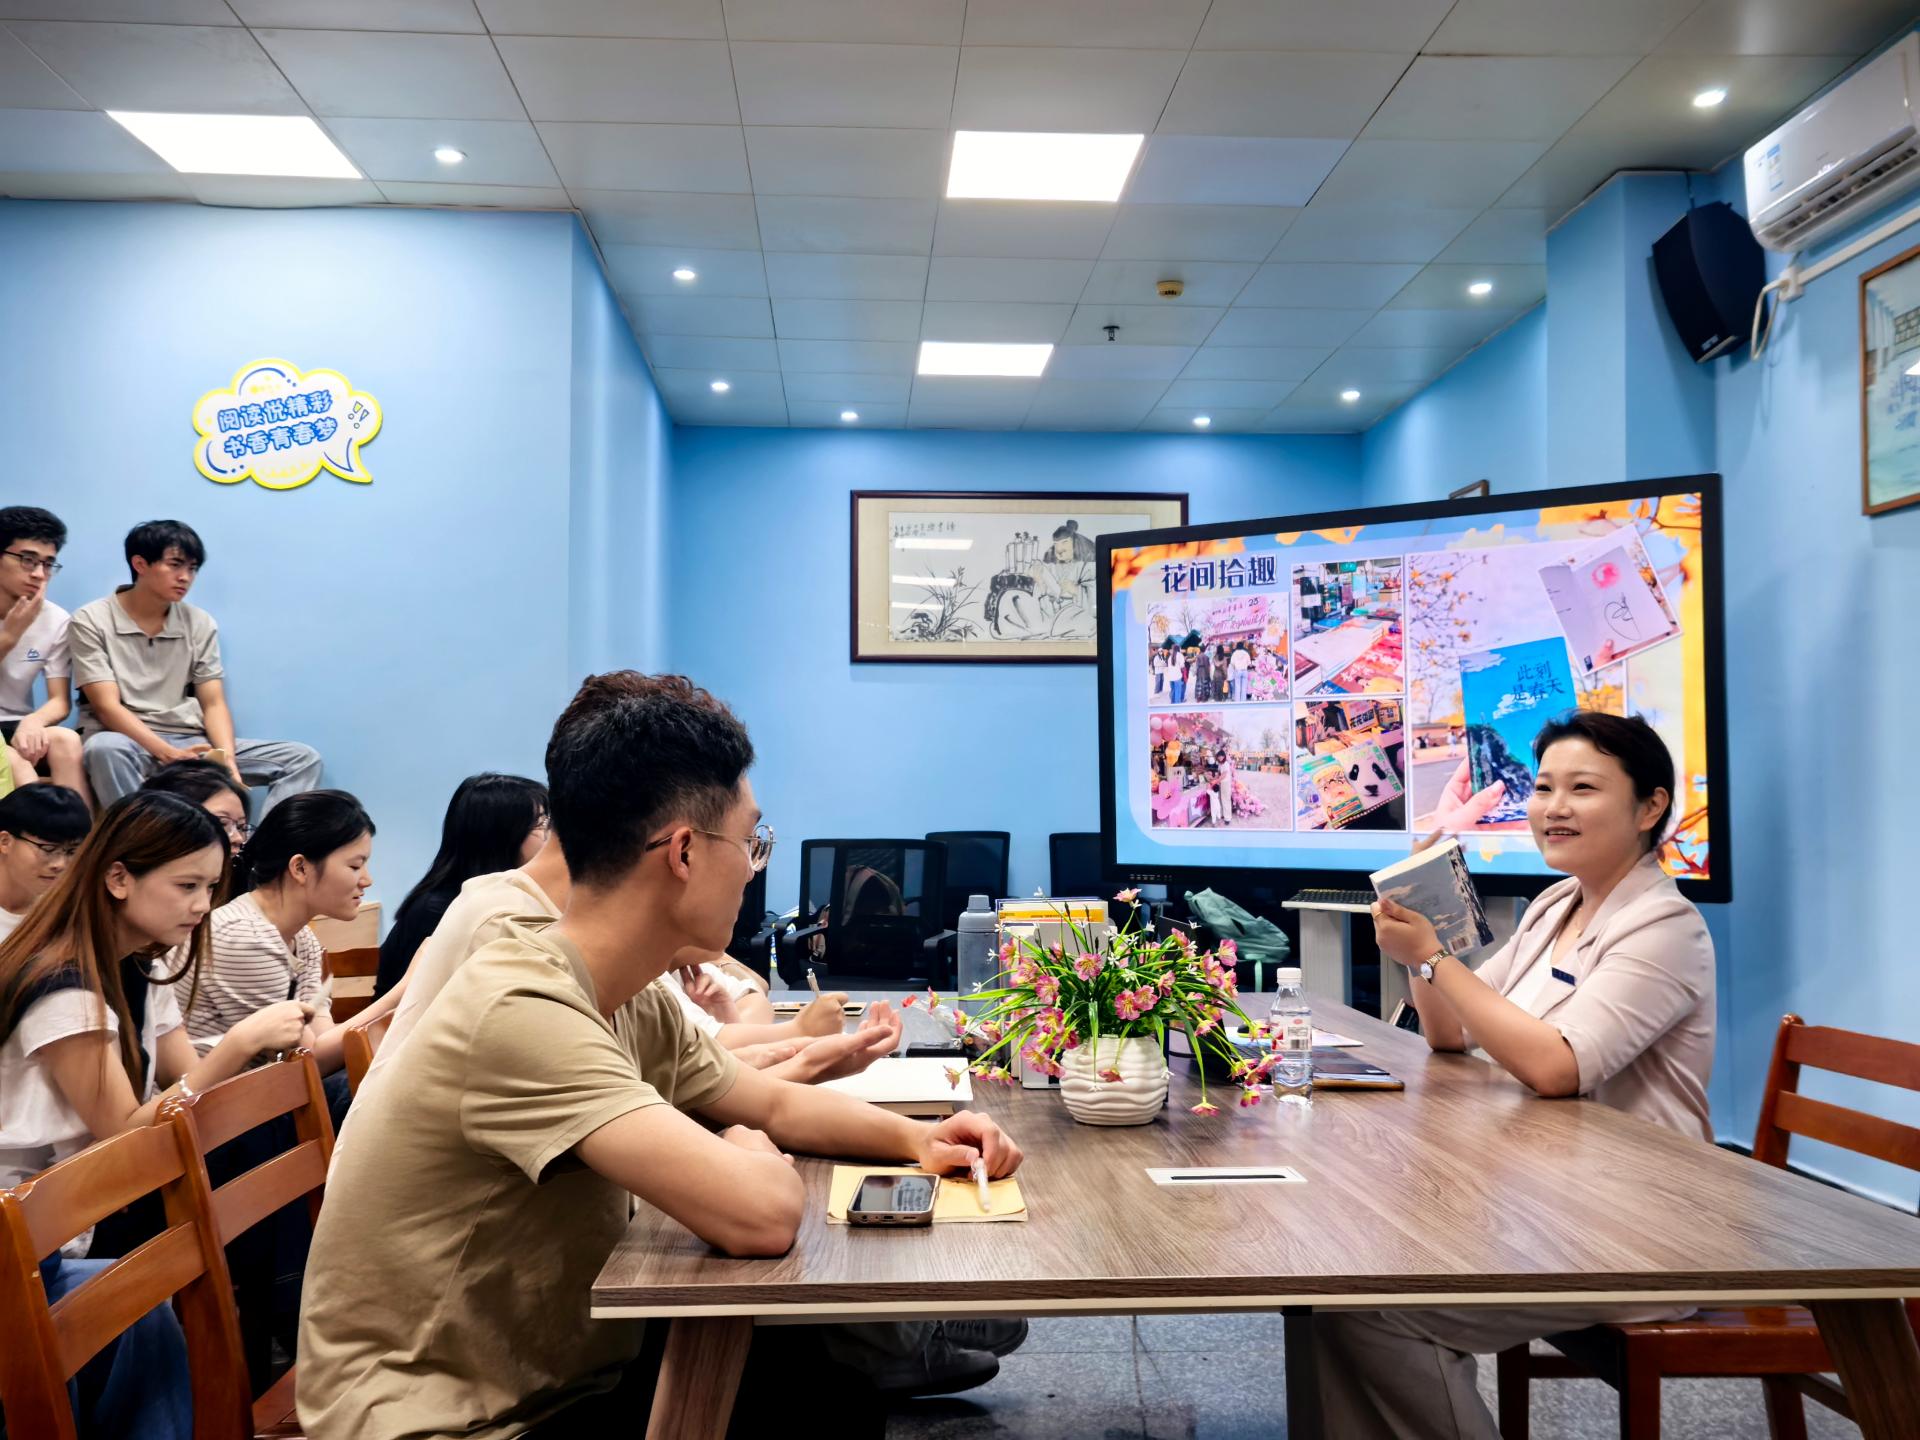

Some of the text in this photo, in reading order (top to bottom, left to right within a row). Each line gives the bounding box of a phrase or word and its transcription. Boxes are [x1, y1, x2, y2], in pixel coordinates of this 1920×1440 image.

[218, 390, 332, 432] 阅读悦精彩
[224, 417, 337, 458] 书香青春梦
[1161, 556, 1276, 593] 花间拾趣
[1518, 660, 1551, 680] 此刻
[1513, 678, 1564, 701] 是春天
